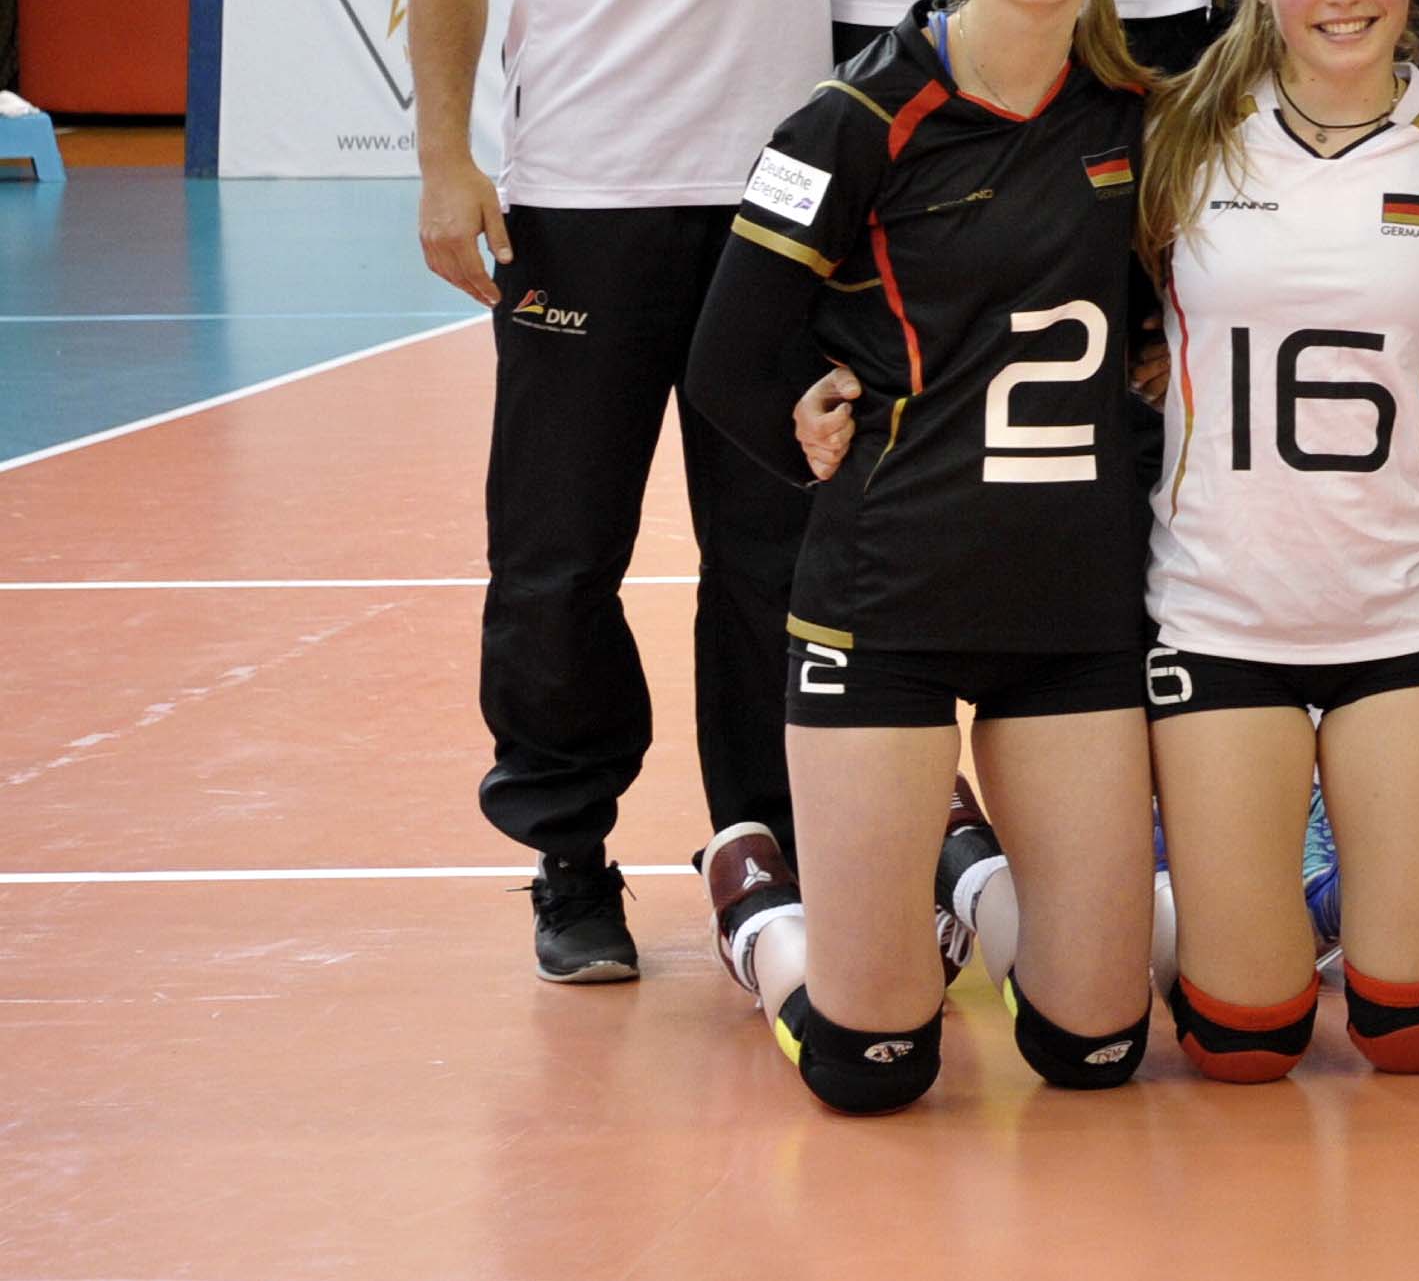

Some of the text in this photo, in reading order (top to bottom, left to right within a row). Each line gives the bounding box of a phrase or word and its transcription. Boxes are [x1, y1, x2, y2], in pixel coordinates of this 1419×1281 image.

[336, 131, 418, 151] www.el
[1210, 200, 1279, 212] STANNO
[545, 308, 588, 327] DVV
[984, 300, 1109, 450] 2
[1231, 327, 1398, 474] 16
